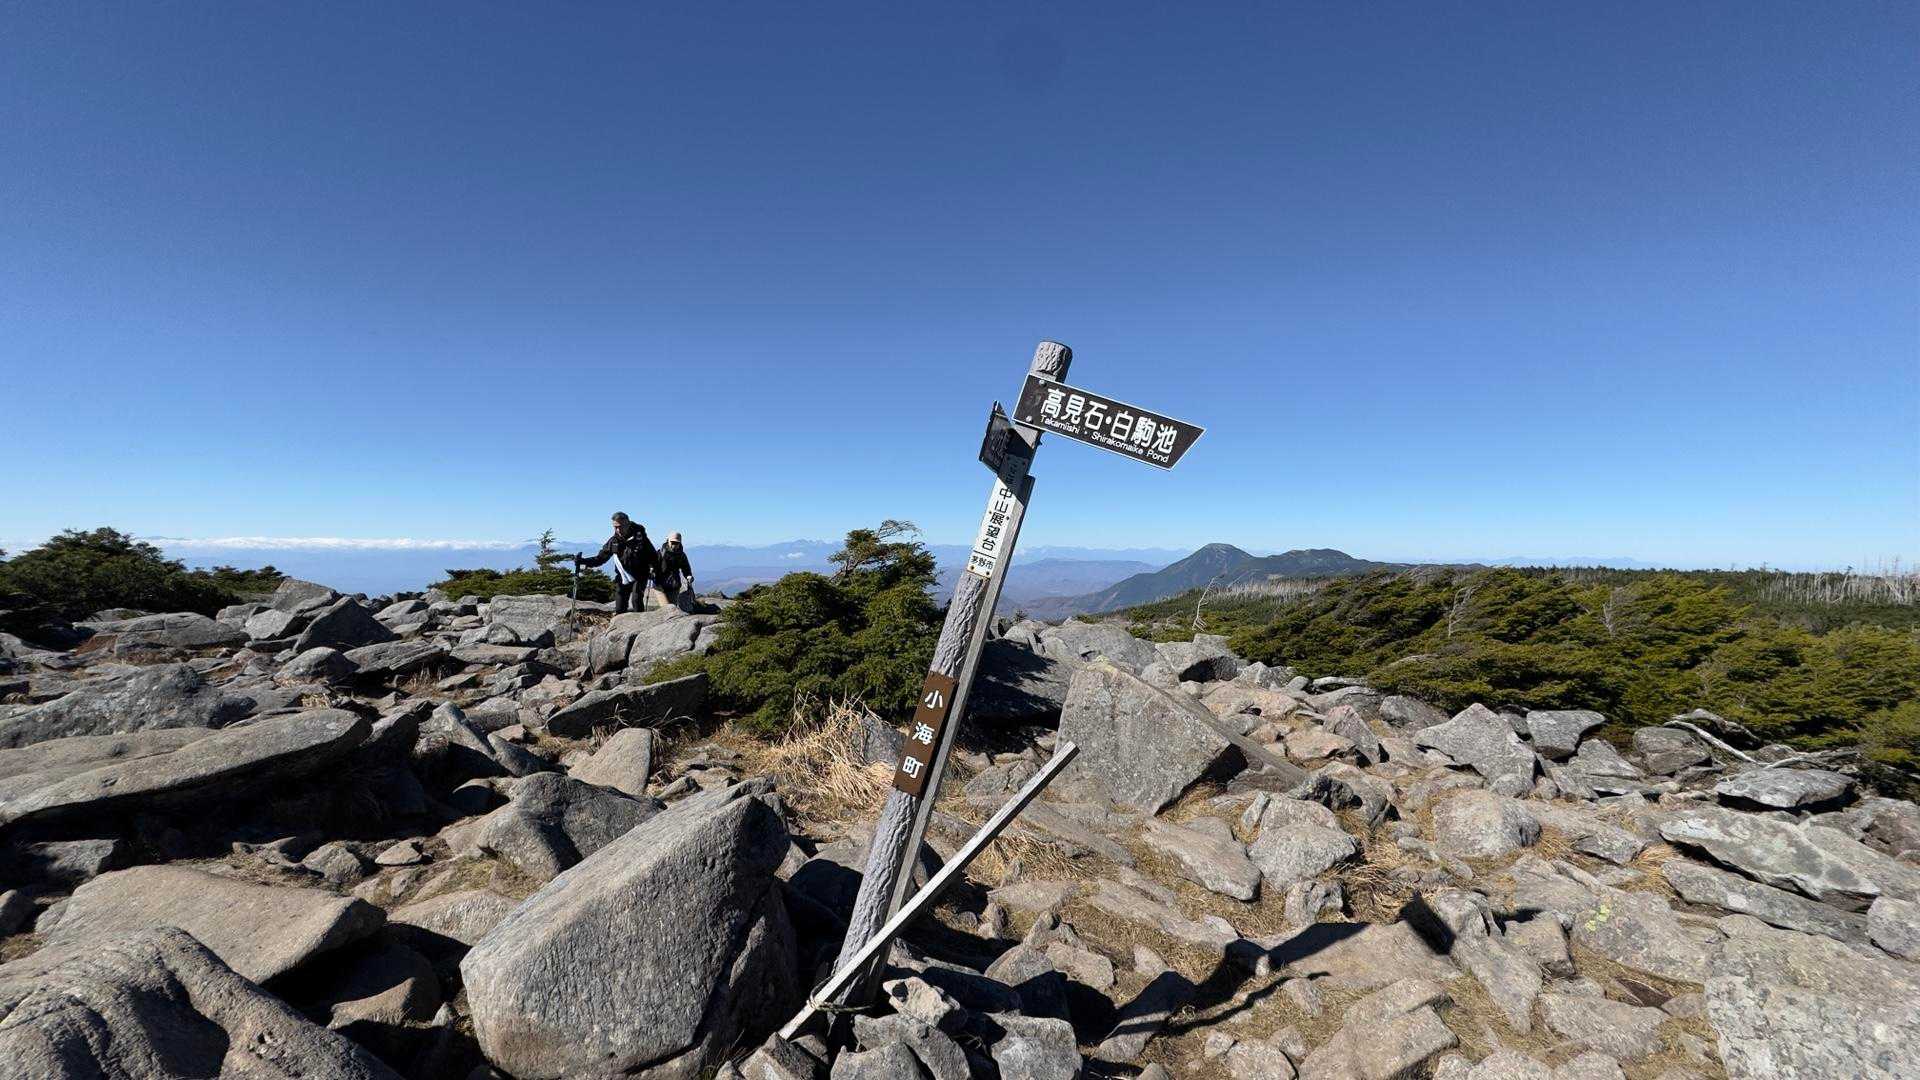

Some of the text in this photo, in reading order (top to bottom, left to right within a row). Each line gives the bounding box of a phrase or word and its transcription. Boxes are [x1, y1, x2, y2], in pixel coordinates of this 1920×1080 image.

[1146, 449, 1170, 463] Pond
[982, 487, 1013, 551] 中山展望台
[902, 690, 943, 779] 小海町
